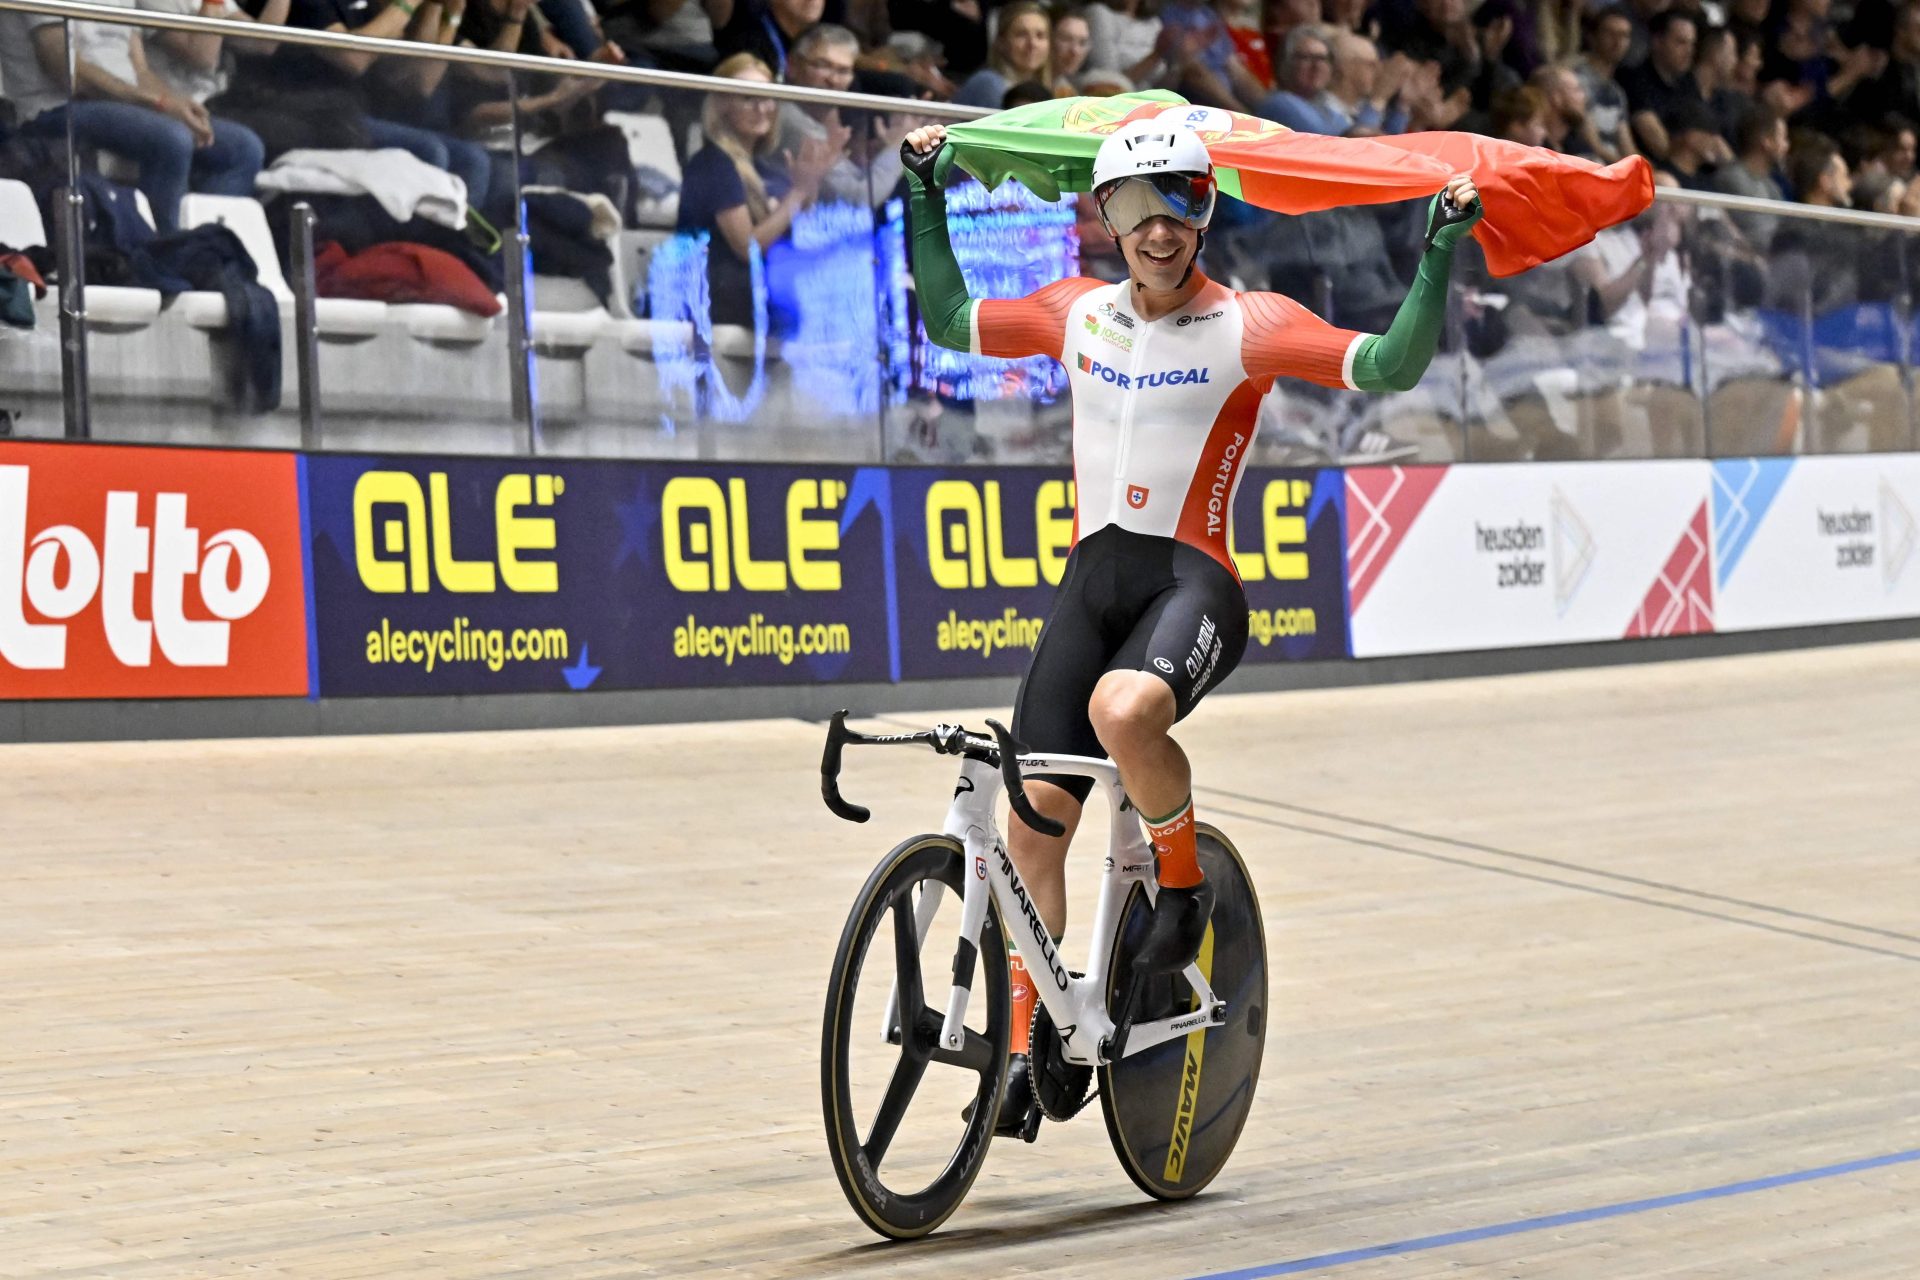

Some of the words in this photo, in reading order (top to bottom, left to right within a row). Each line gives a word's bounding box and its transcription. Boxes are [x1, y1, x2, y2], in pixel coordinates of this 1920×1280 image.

[1136, 160, 1170, 168] MET
[1100, 326, 1133, 348] JOGOS
[1194, 311, 1223, 323] PACTO
[1091, 361, 1210, 390] PORTUGAL
[1208, 432, 1245, 536] PORTUGAL
[0, 465, 270, 669] lotto
[366, 617, 568, 673] alecycling.com
[674, 613, 850, 666] alecycling.com
[1197, 614, 1215, 657] RURAL
[994, 842, 1068, 992] PINARELLO
[1171, 1015, 1207, 1031] PINARELLO
[1170, 1050, 1198, 1175] MAVIC
